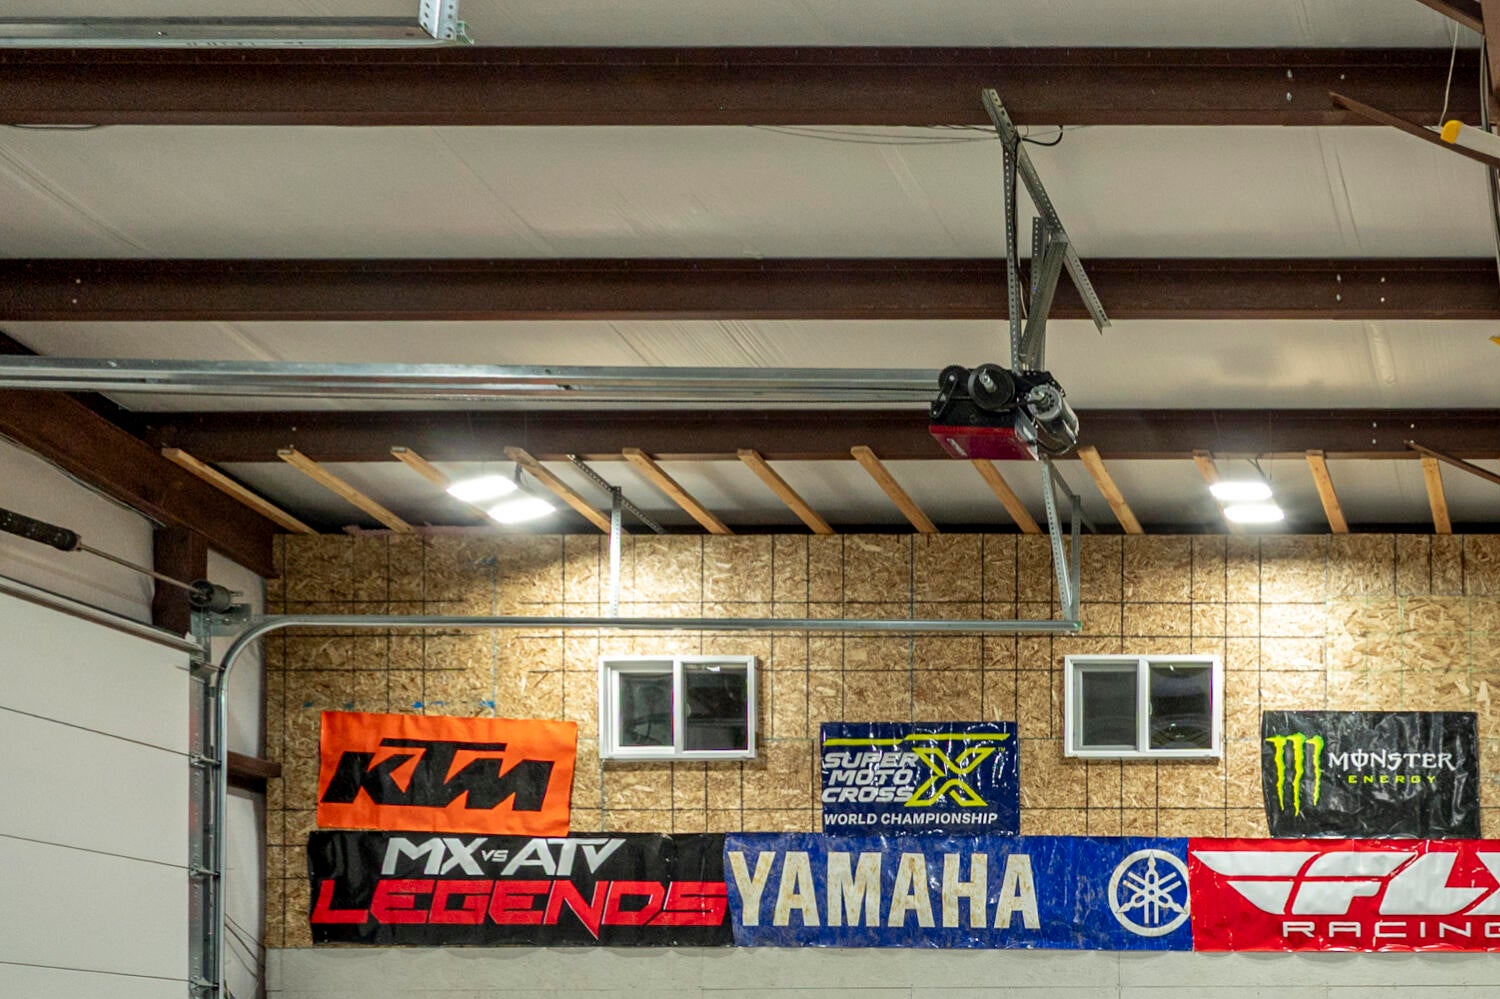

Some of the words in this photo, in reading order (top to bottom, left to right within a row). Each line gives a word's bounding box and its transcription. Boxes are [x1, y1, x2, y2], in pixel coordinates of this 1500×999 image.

[824, 752, 920, 768] SUPER
[1328, 748, 1457, 772] MONSTER
[322, 738, 554, 811] KTM
[828, 769, 914, 786] MOTO
[1348, 775, 1436, 784] ENERGY
[821, 786, 915, 803] CROSS
[824, 813, 878, 825] WORLD
[880, 812, 998, 825] CHAMPIONSHIP
[381, 837, 488, 875] MX
[501, 837, 627, 875] ATV
[728, 850, 1041, 930] YAMAHA
[310, 880, 728, 940] LEGENDS
